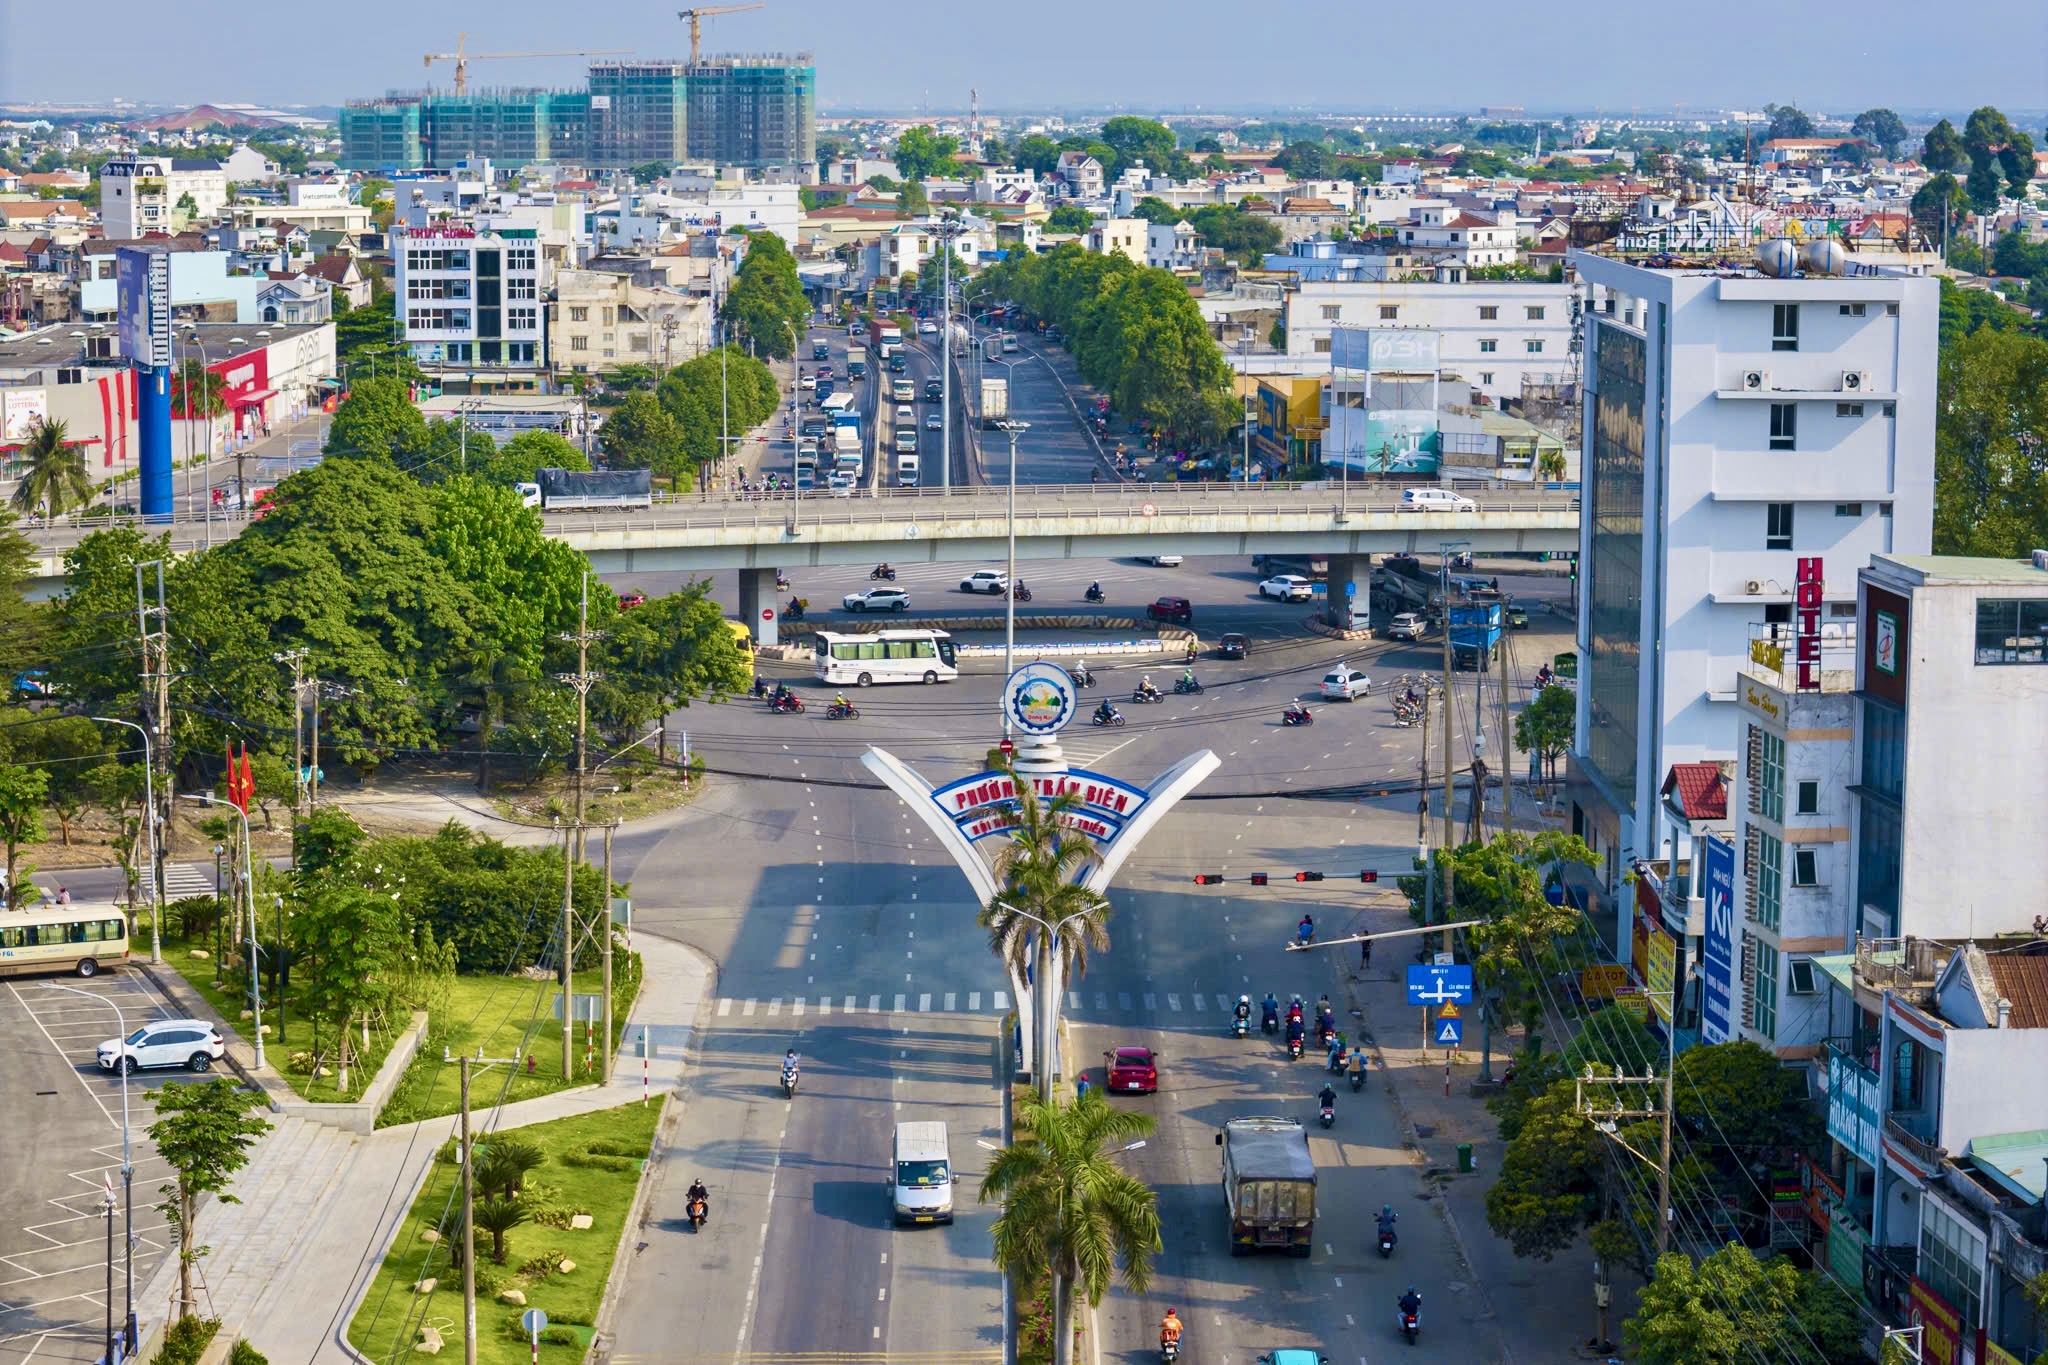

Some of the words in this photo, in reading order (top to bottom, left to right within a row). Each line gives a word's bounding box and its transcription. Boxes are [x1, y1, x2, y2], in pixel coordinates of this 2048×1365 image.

[8, 401, 39, 409] LOTTERIA
[1798, 558, 1823, 689] HOTEL
[1085, 785, 1128, 813] BIÊN
